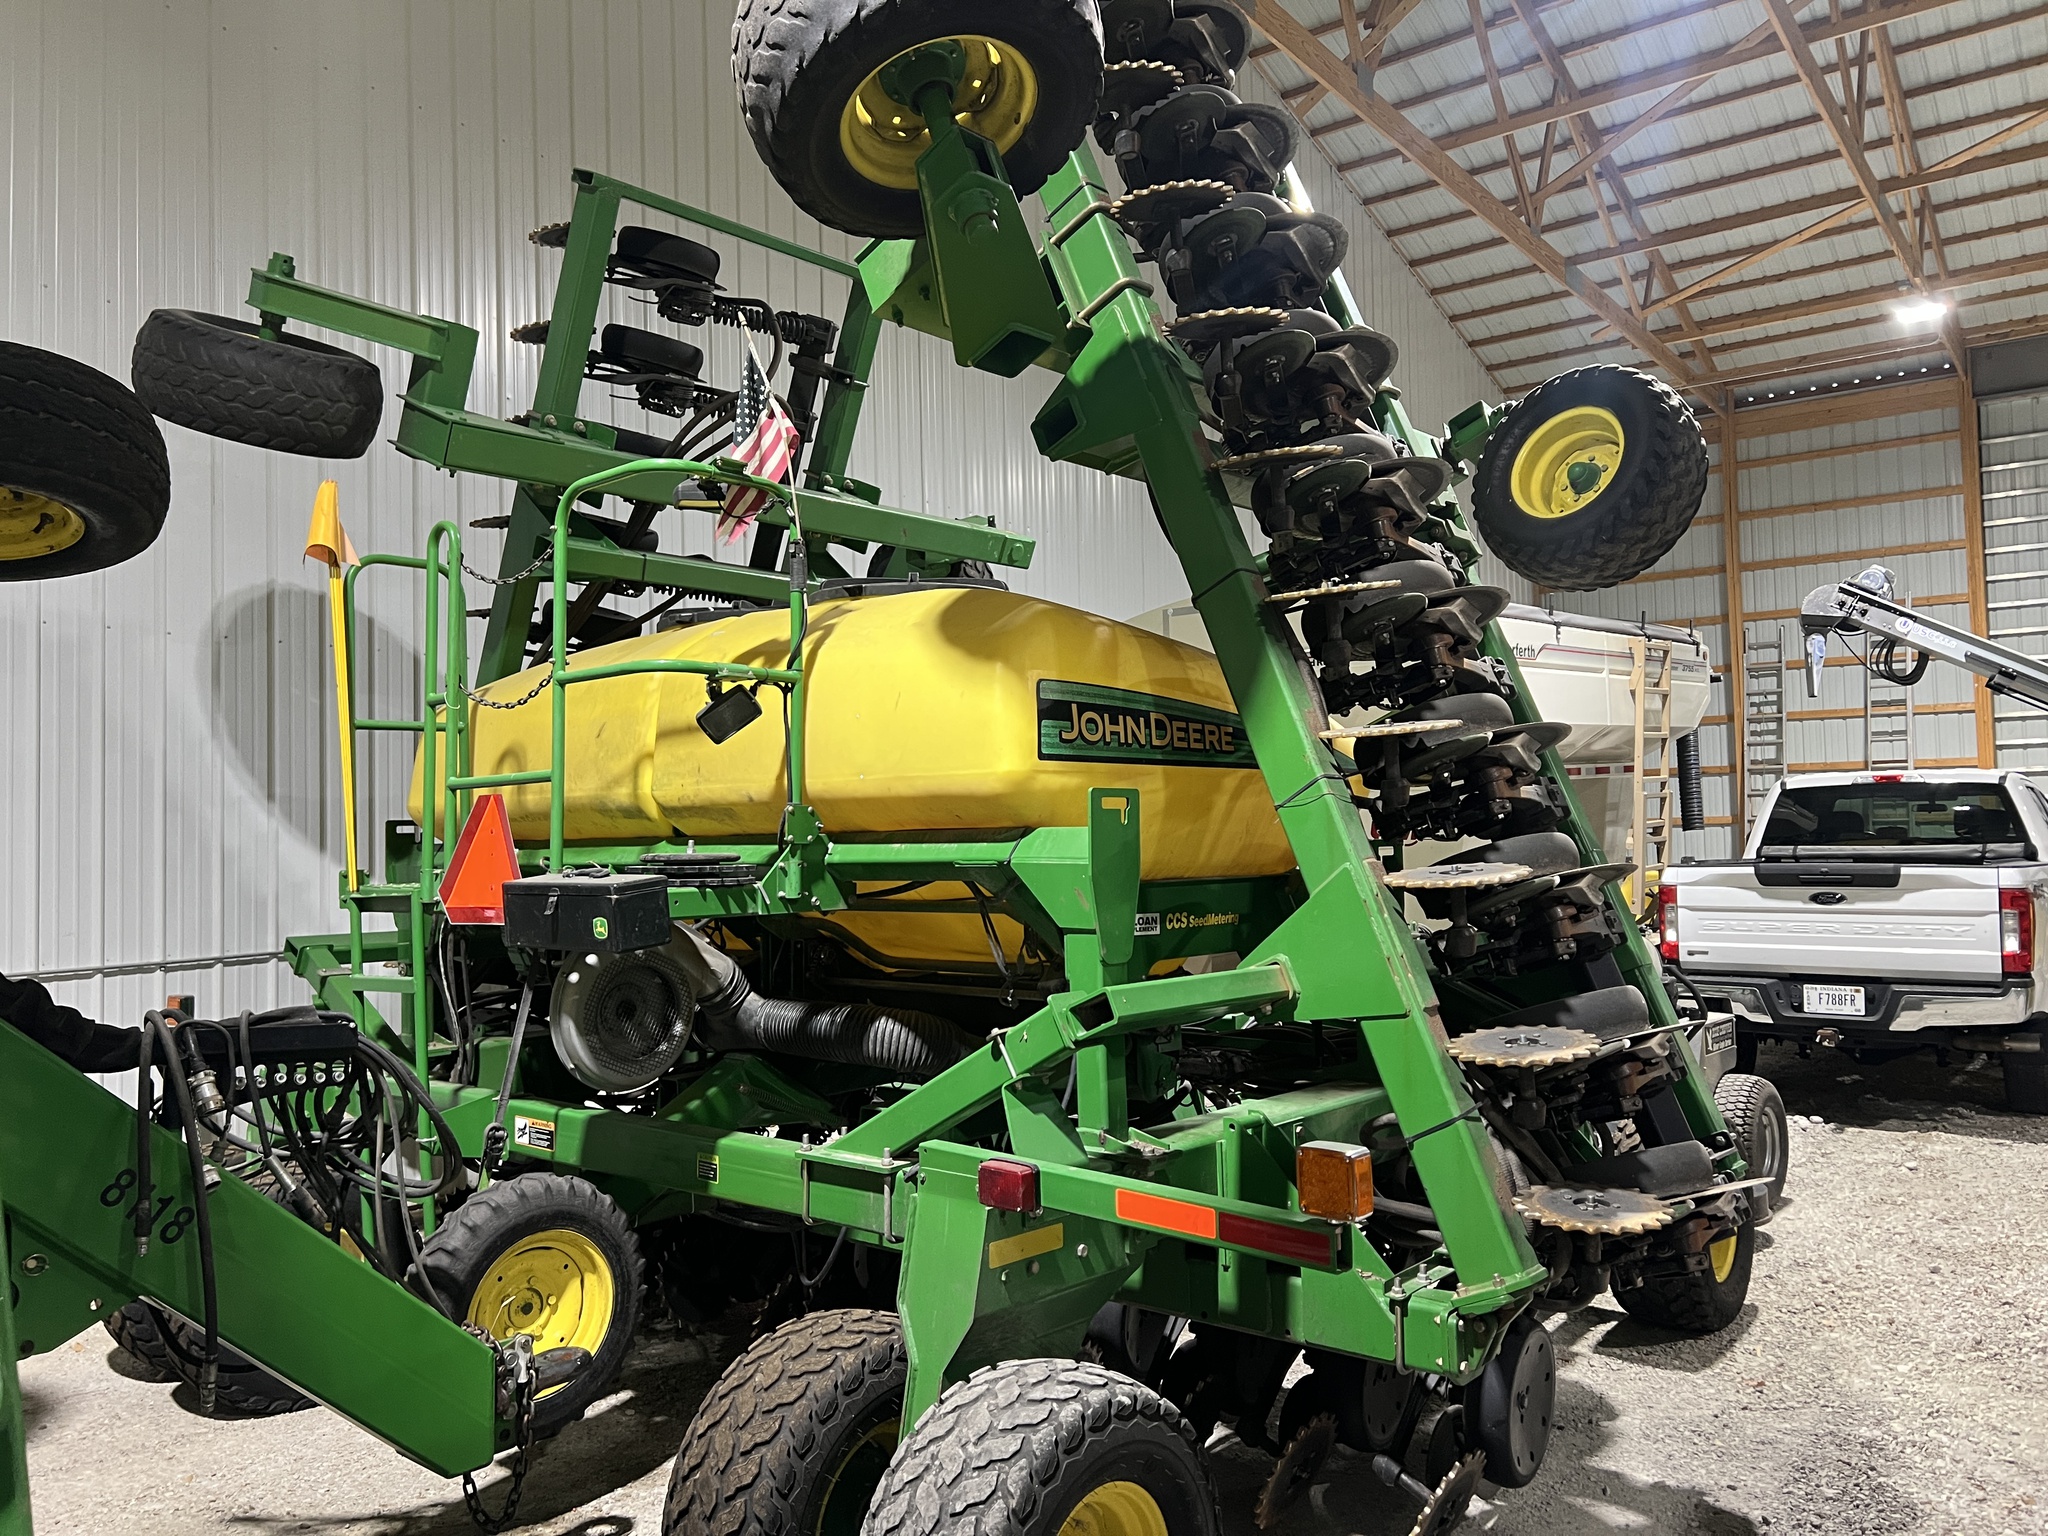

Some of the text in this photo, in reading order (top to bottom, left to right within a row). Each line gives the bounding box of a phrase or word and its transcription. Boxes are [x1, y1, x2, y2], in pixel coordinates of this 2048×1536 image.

[1061, 703, 1235, 751] JOHN DEERE
[1135, 916, 1157, 926] OAN
[1166, 911, 1239, 930] CCS SeedMetering
[1703, 920, 1972, 938] SUPER DUTY
[1818, 992, 1856, 1007] F788FR
